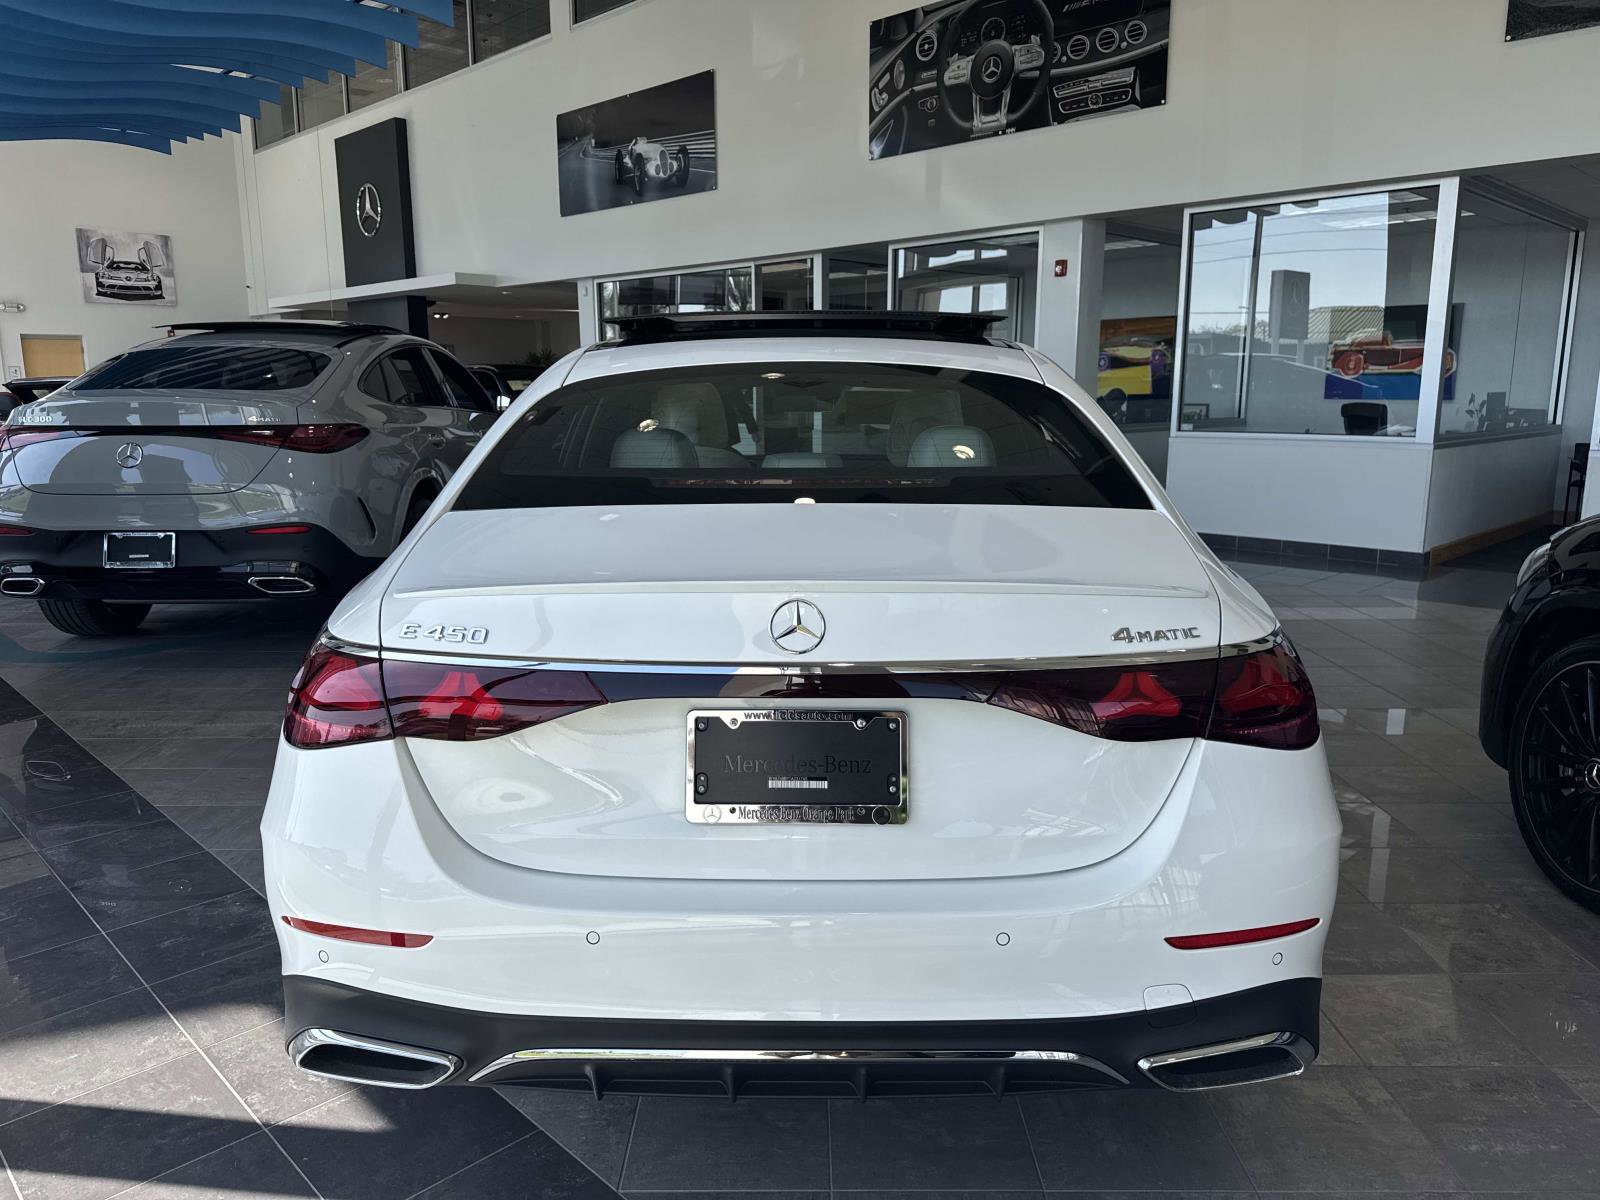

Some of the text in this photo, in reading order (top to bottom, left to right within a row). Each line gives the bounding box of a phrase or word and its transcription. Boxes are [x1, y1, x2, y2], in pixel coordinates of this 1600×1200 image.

[399, 623, 489, 644] E 450
[1111, 626, 1201, 643] 4MATIC
[723, 755, 871, 774] Mercedes-Benz
